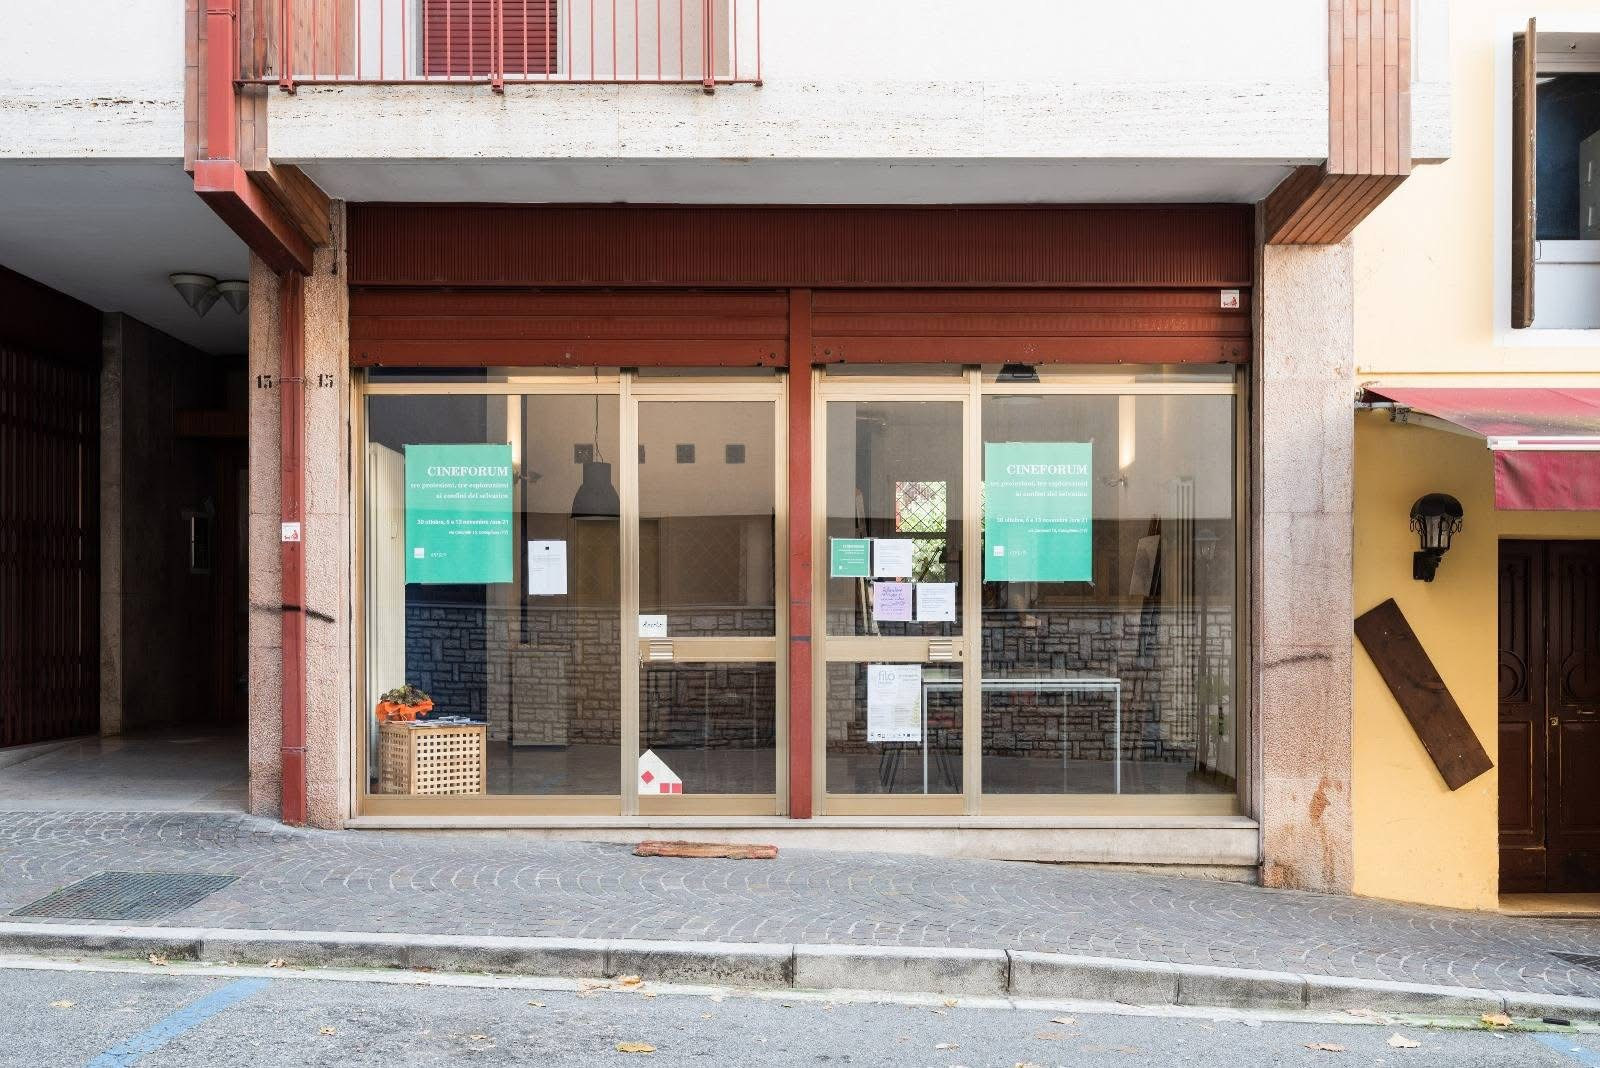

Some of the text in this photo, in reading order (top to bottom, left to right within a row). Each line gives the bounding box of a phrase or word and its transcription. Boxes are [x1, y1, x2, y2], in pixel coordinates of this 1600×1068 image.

[427, 466, 509, 477] CINEFORUM
[1006, 464, 1088, 476] CINEFORUM
[878, 669, 896, 681] filo
